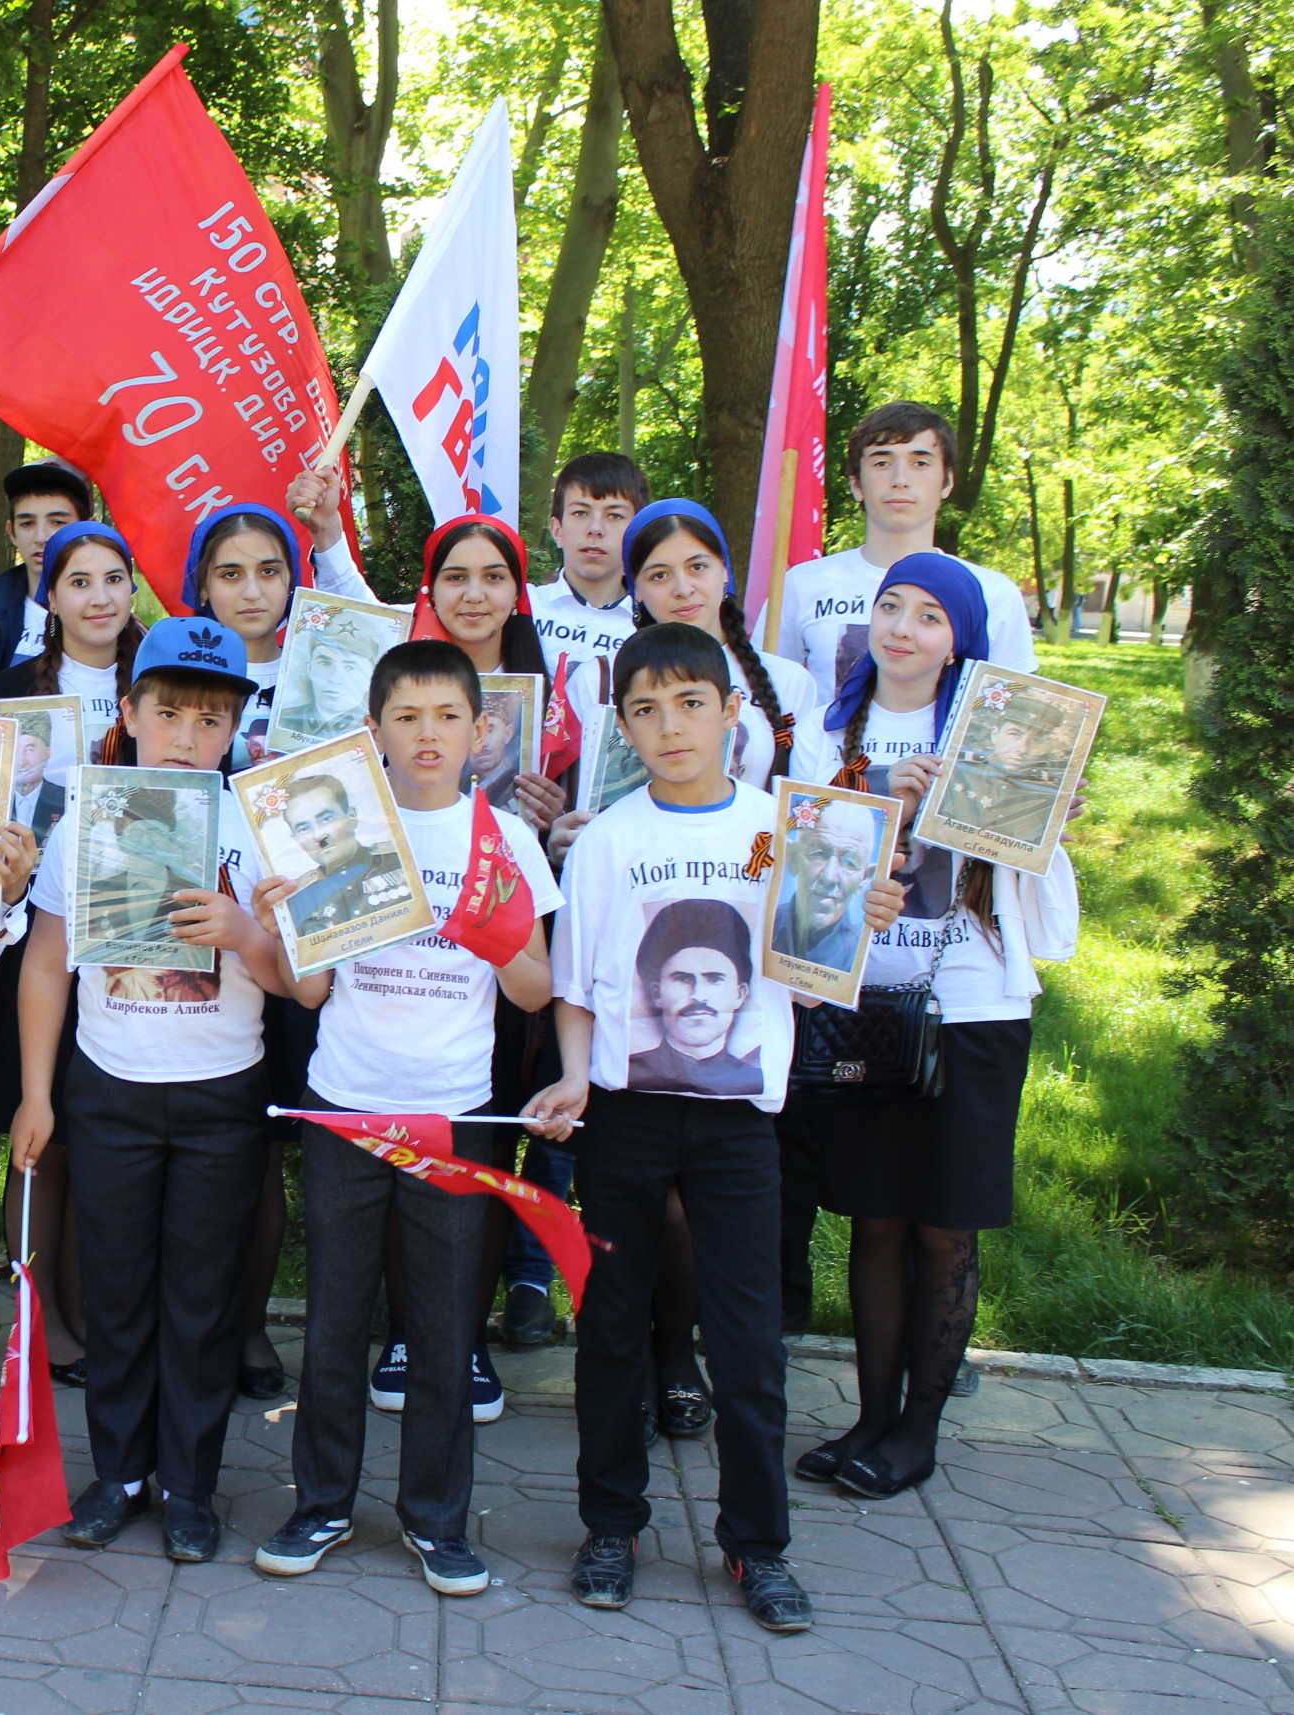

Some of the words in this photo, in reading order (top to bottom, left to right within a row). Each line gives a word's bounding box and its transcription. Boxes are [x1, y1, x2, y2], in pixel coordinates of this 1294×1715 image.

[197, 201, 267, 274] 150
[190, 266, 306, 433] КУТУЗОВА
[815, 594, 865, 619] Мой
[535, 619, 587, 643] Мой
[177, 650, 228, 669] adidas
[943, 817, 975, 834] Агаев
[977, 828, 1034, 853] Сагадулла
[963, 841, 999, 858] с.Гели
[629, 857, 677, 889] Мой
[309, 921, 368, 946] Шанавазов
[370, 906, 411, 927] Даниял
[340, 934, 374, 951] с.Гели
[353, 962, 403, 979] Похоронен
[406, 970, 416, 979] п.
[419, 967, 470, 984] Синявино
[789, 976, 814, 990] с.Гели
[350, 978, 426, 997] Ленинградская
[428, 986, 468, 1001] область
[105, 997, 168, 1015] Каирбеков
[174, 1002, 220, 1014] Алибек
